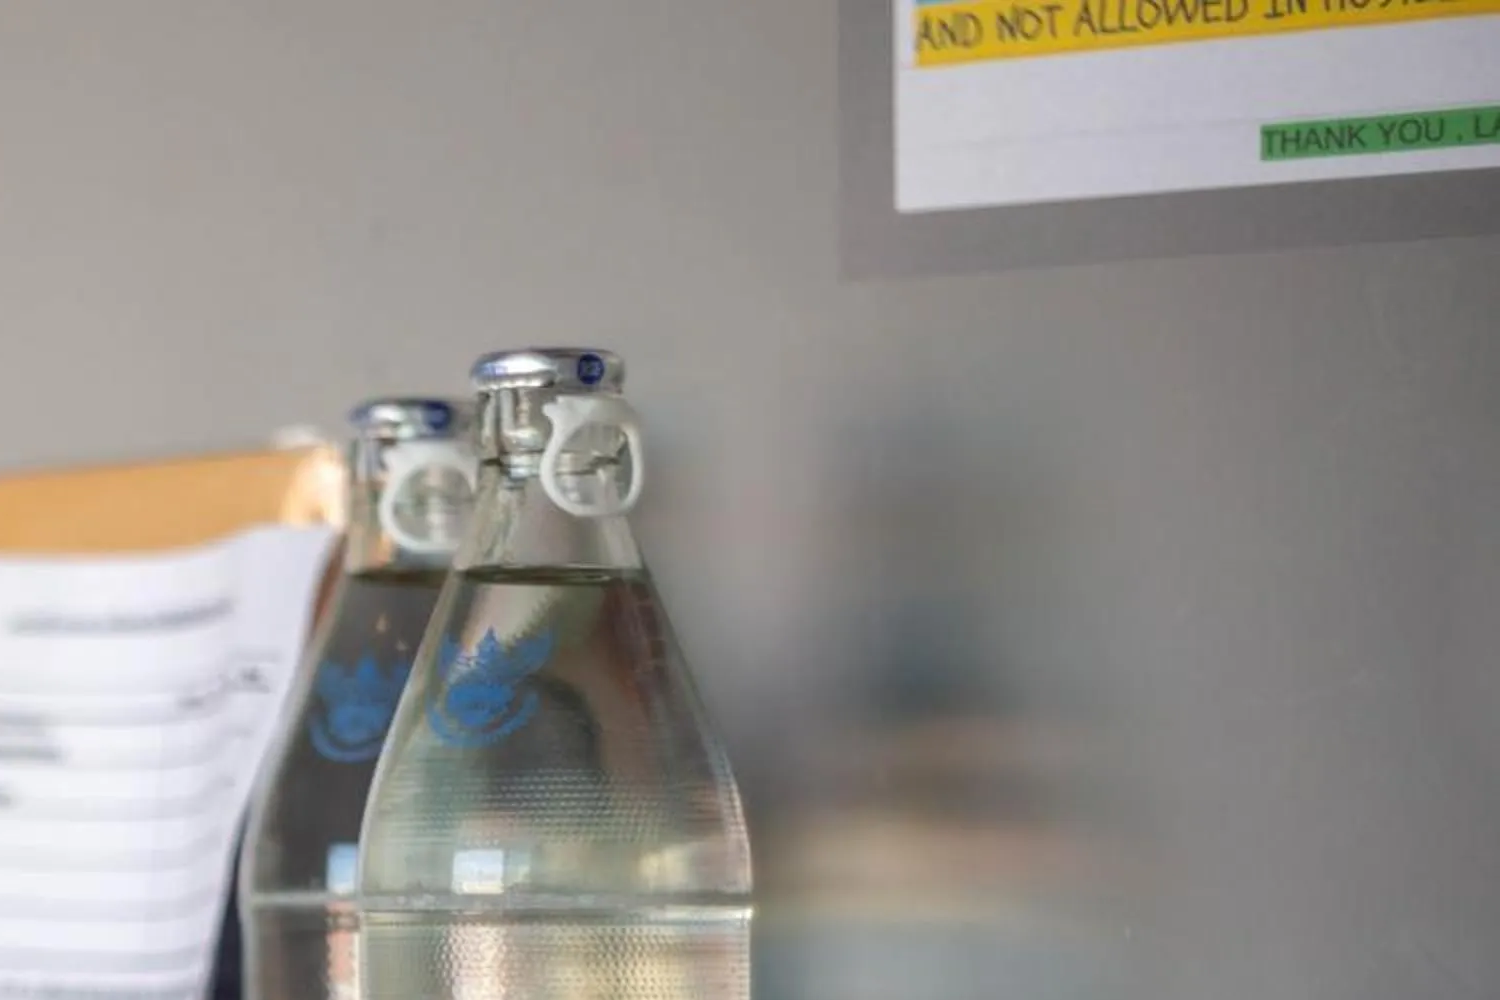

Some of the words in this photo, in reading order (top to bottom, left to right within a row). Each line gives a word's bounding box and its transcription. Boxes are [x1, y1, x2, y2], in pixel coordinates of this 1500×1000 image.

[916, 14, 984, 51] AND
[997, 3, 1063, 42] NOT
[1073, 0, 1250, 37] ALLOWED
[1263, 124, 1368, 155] THANK
[1377, 116, 1445, 144] YOU
